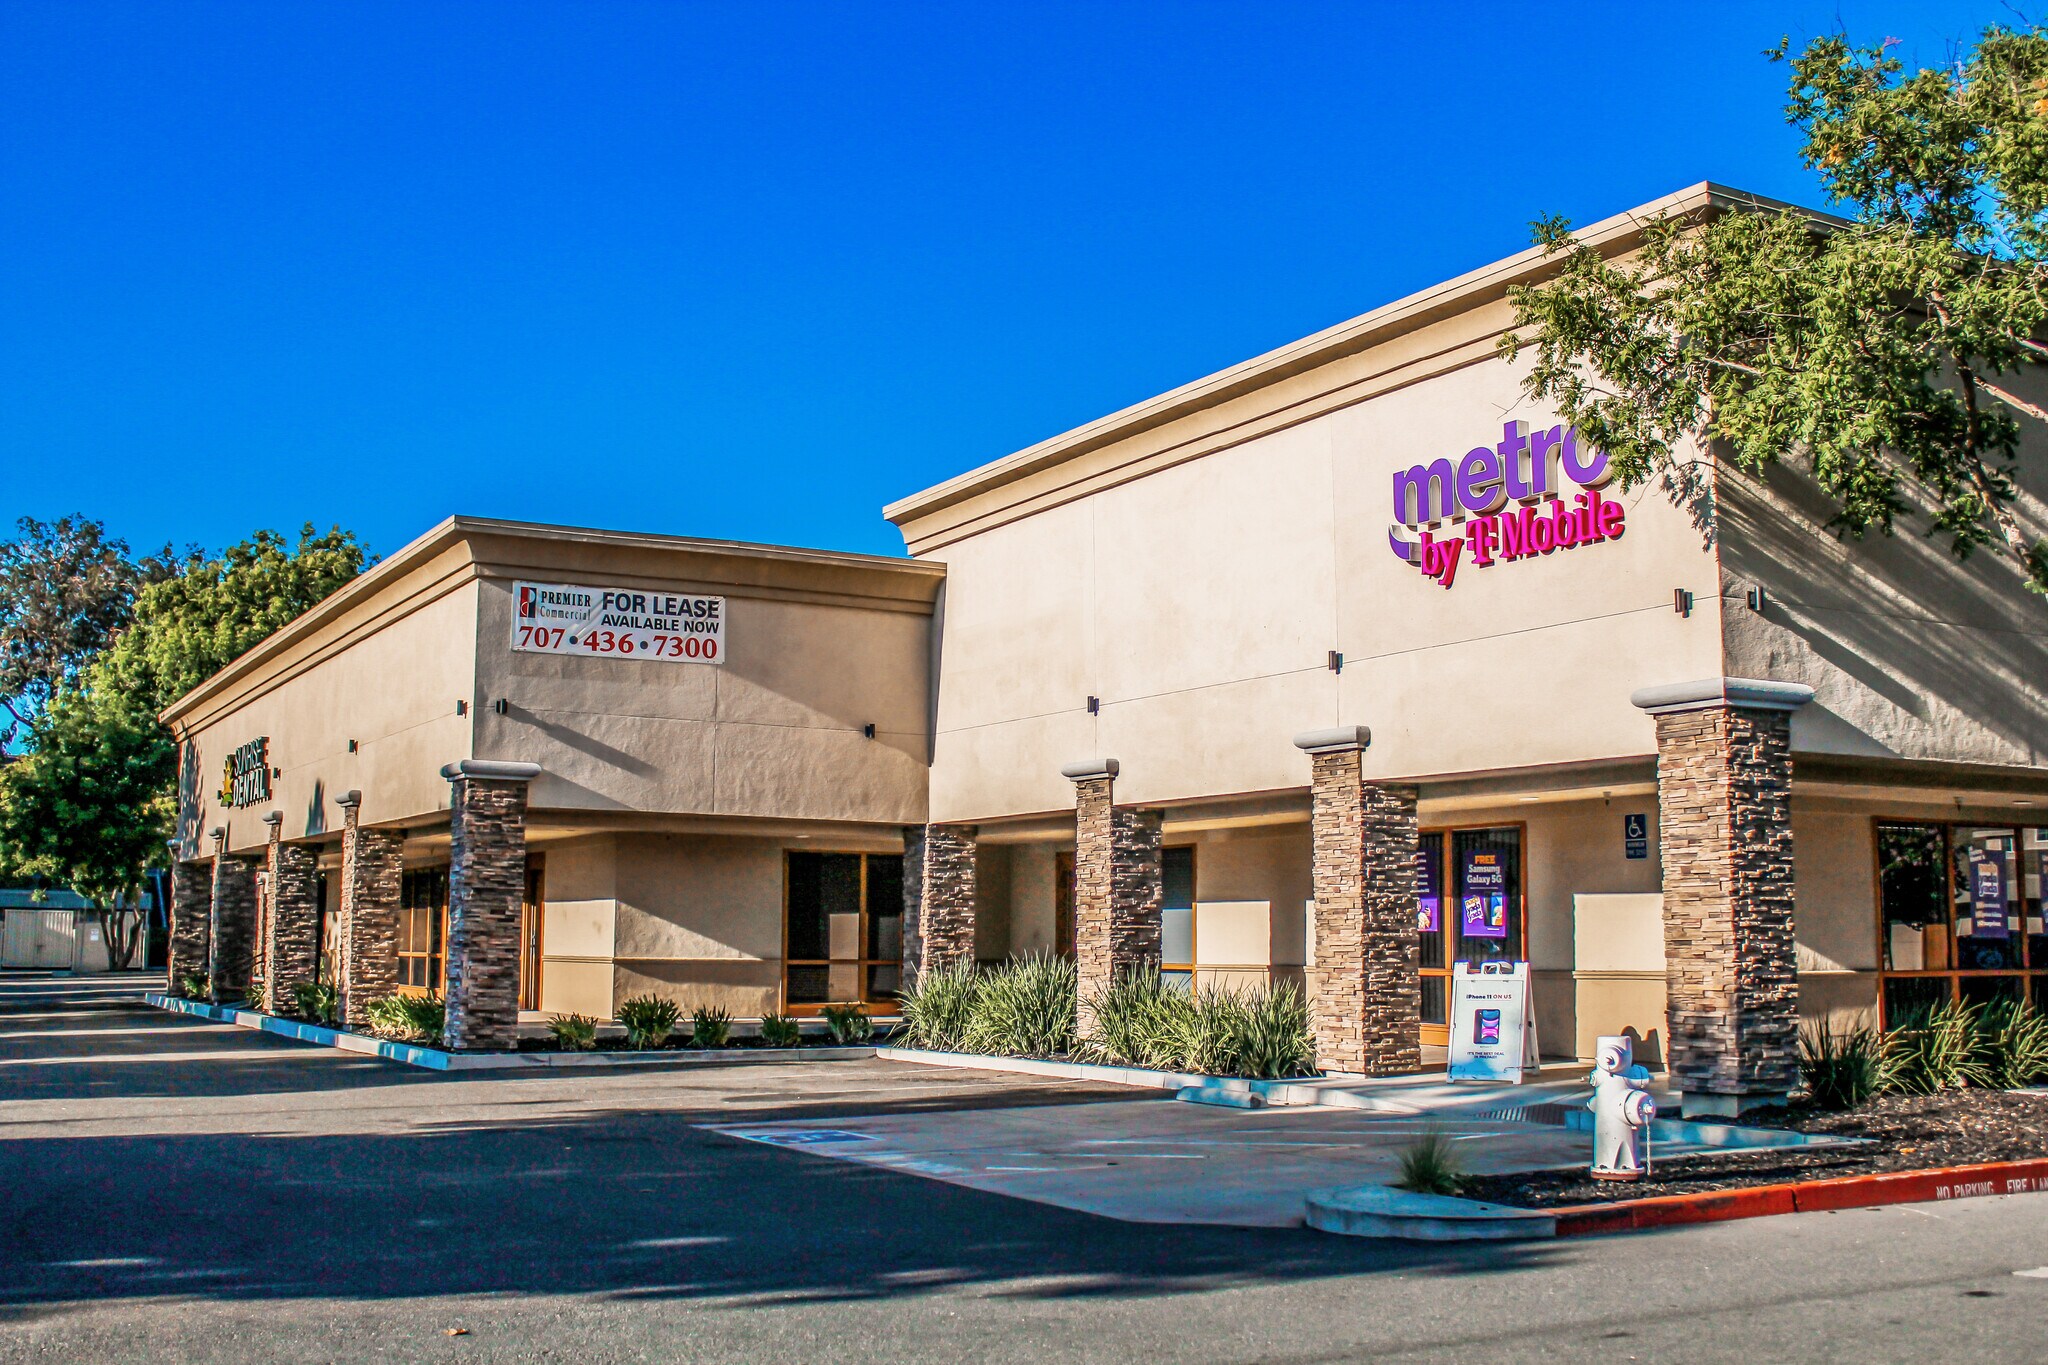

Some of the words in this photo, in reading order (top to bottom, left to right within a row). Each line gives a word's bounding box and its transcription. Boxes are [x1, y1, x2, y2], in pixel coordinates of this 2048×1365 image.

[1392, 420, 1612, 525] metro
[1420, 532, 1465, 590] by
[541, 591, 591, 607] PREMIER
[602, 592, 647, 614] FOR
[653, 596, 720, 619] LEASE
[540, 605, 591, 621] Commercial
[601, 614, 680, 632] AVAILABLE
[684, 621, 720, 634] NOW
[233, 768, 268, 807] DENTAL
[1468, 864, 1501, 875] Samsung
[1475, 855, 1496, 864] FREE
[1466, 875, 1491, 885] Galaxy
[1491, 875, 1503, 884] 5G
[1936, 1185, 1951, 1199] NO
[1954, 1181, 1994, 1198] PARKING
[2006, 1178, 2028, 1194] FIRE
